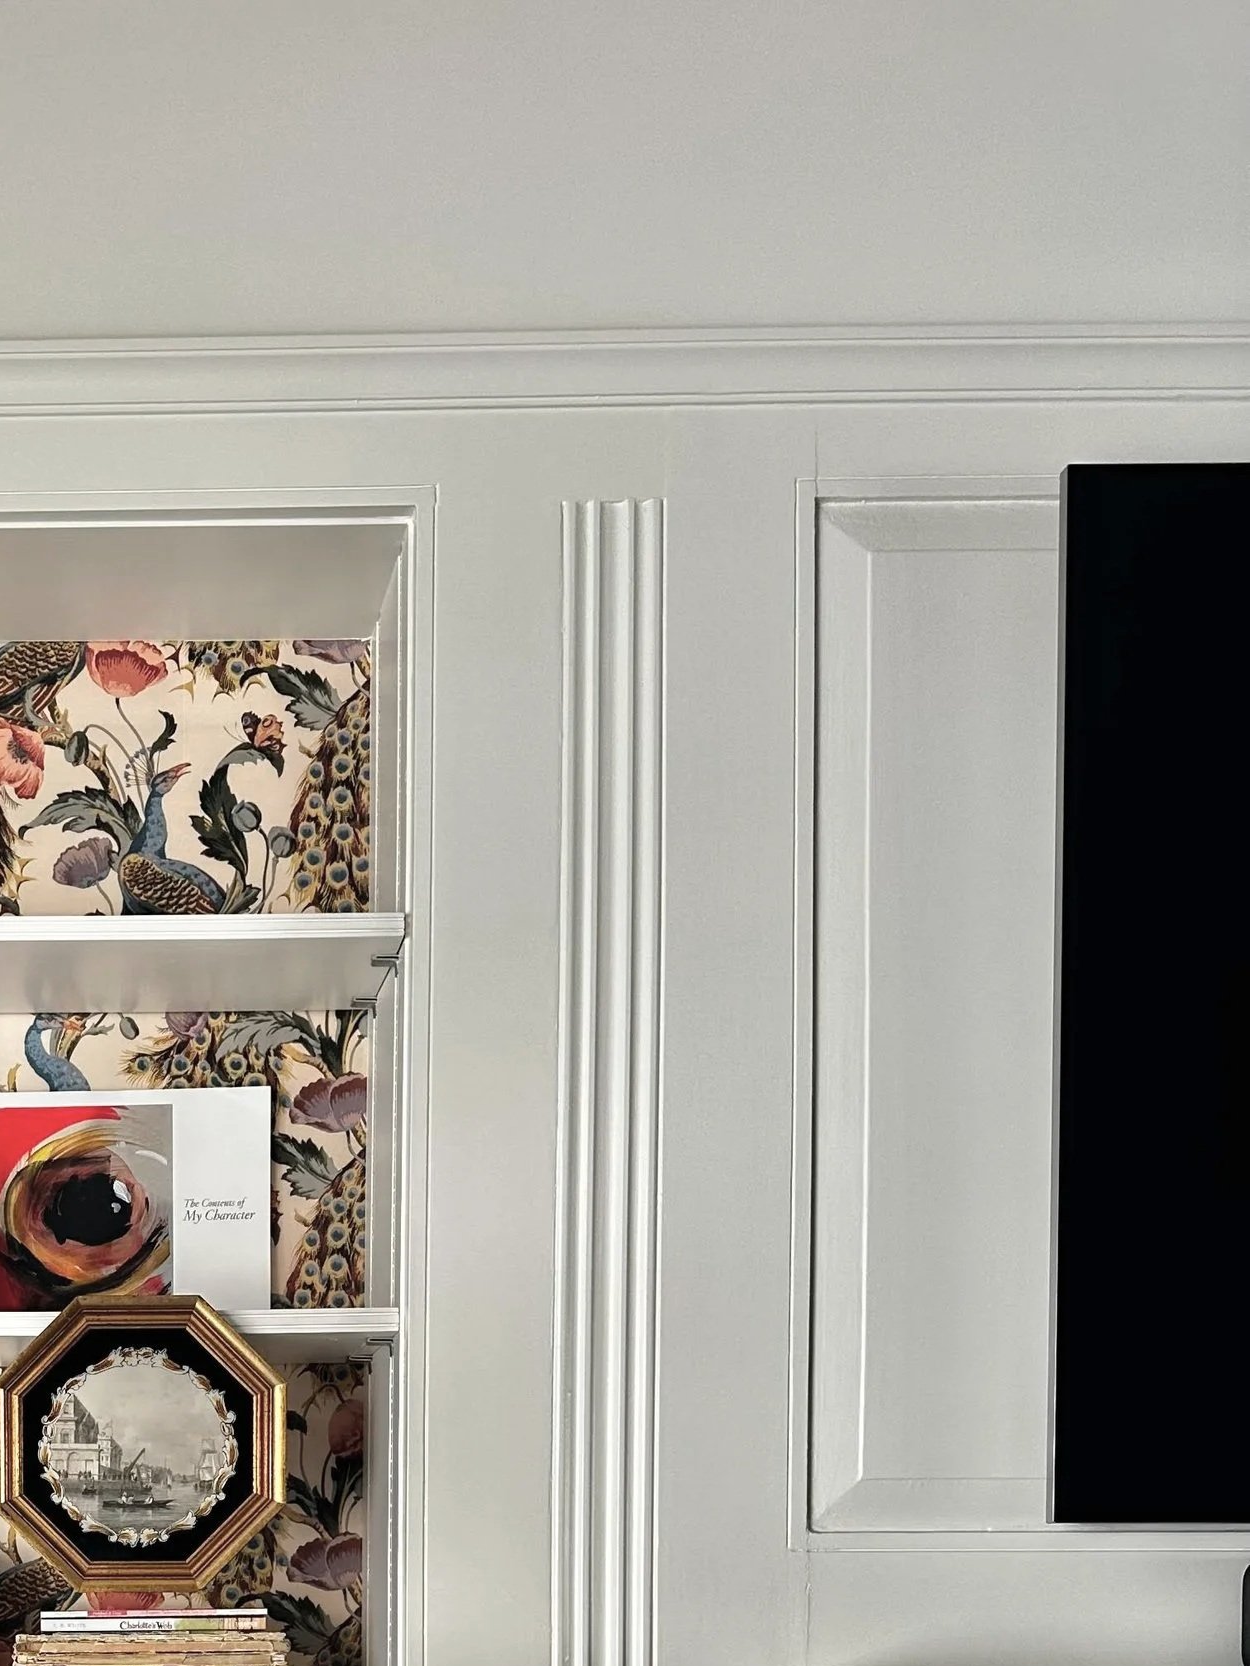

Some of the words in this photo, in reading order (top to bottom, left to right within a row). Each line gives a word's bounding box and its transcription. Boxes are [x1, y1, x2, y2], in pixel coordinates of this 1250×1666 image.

[183, 1198, 199, 1208] The
[201, 1198, 235, 1208] Contents
[237, 1196, 247, 1209] of
[183, 1210, 202, 1224] My
[205, 1209, 256, 1221] Character
[119, 1621, 156, 1630] Charlotte's
[157, 1621, 173, 1630] Web
